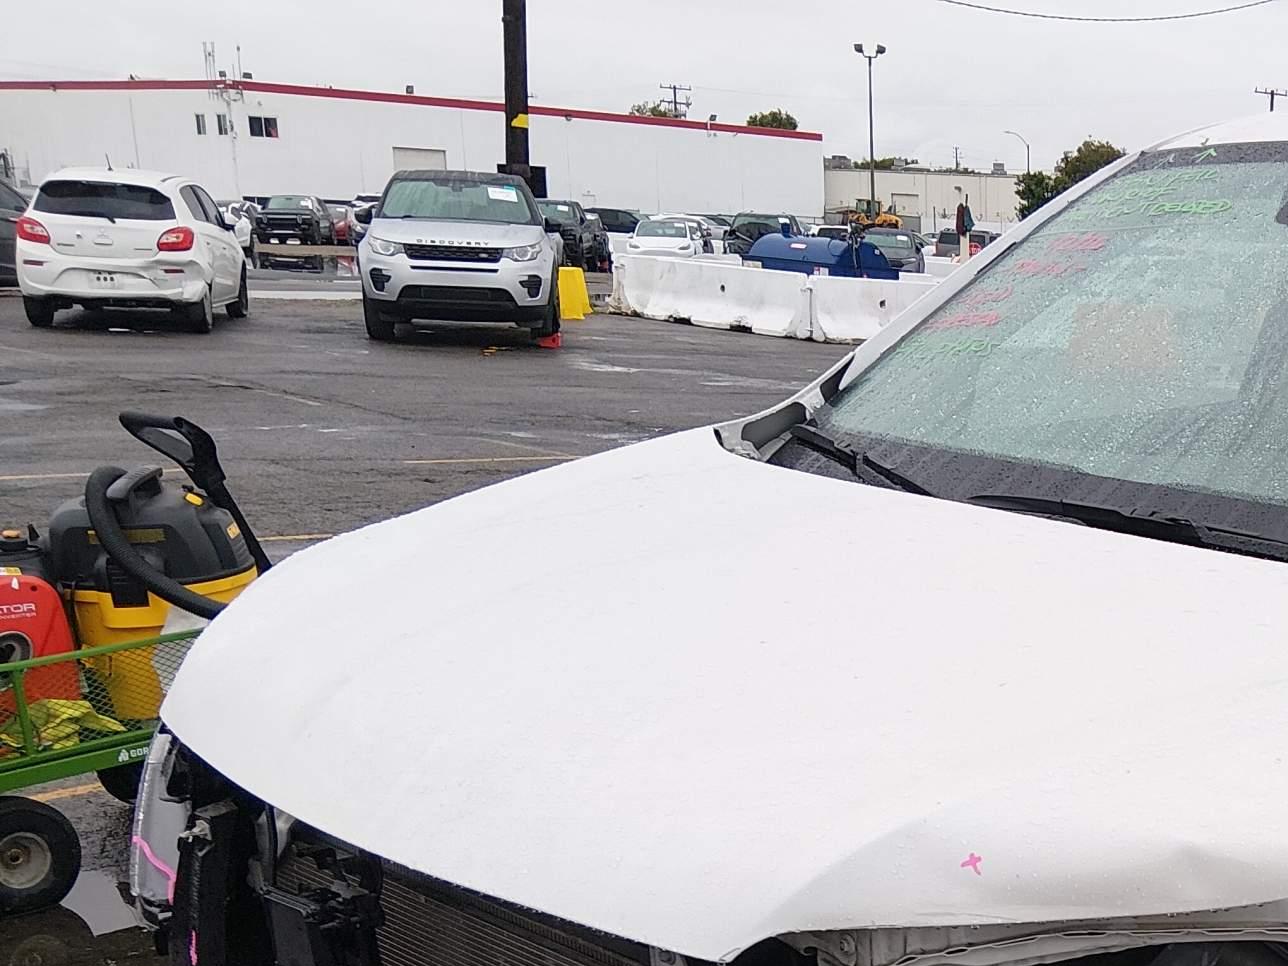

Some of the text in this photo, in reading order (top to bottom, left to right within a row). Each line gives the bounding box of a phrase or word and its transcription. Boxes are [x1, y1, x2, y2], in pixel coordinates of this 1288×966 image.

[416, 238, 489, 246] DISCOVERY
[0, 603, 36, 613] TOR
[130, 747, 150, 757] GOR
